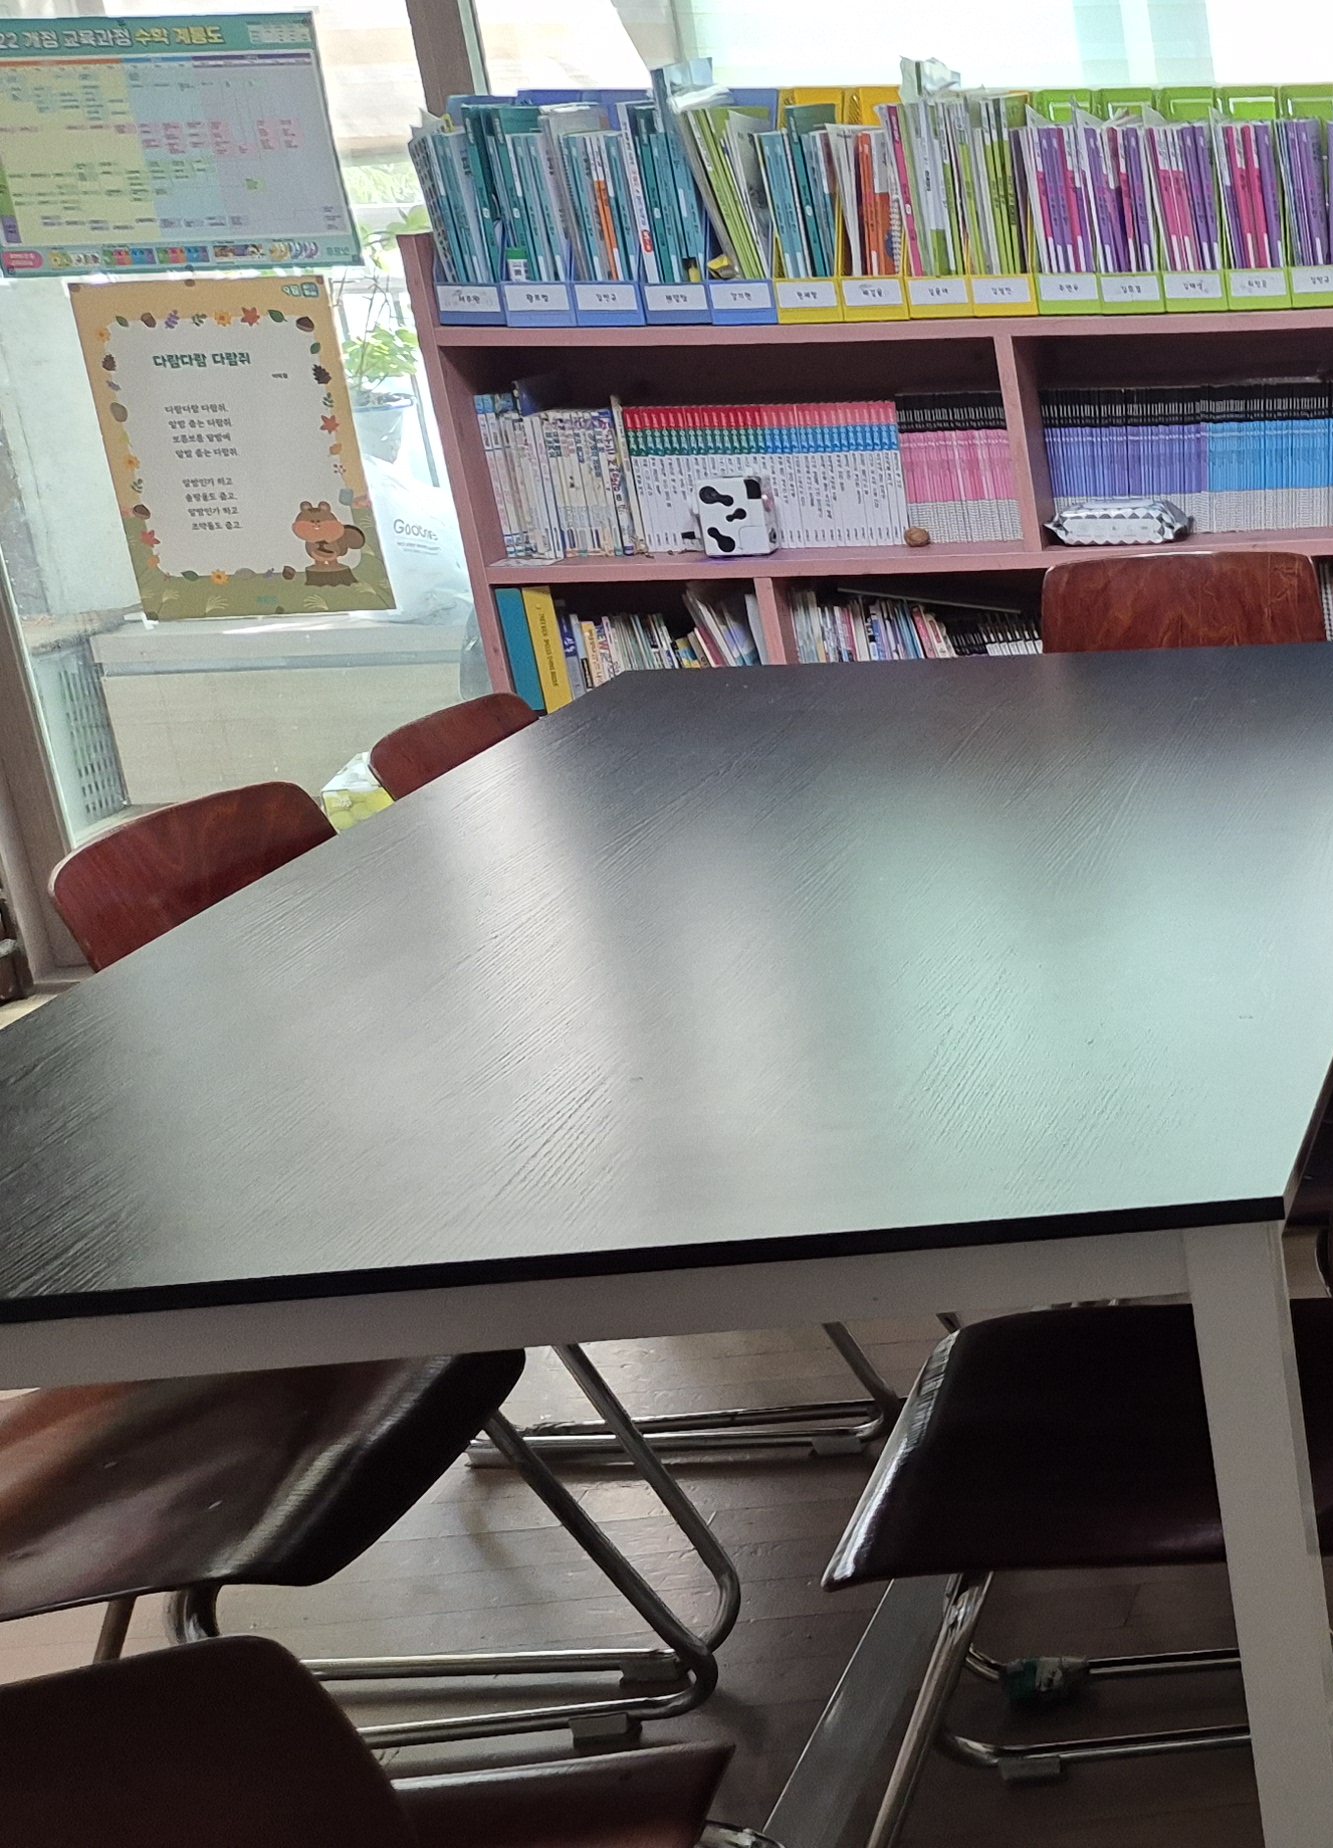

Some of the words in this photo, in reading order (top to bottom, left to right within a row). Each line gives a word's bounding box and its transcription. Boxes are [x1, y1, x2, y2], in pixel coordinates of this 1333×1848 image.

[22, 29, 58, 49] 개정
[62, 28, 132, 48] 교육과정
[134, 27, 170, 45] 수학
[152, 352, 207, 369] 다람다람
[211, 351, 251, 366] 다람쥐
